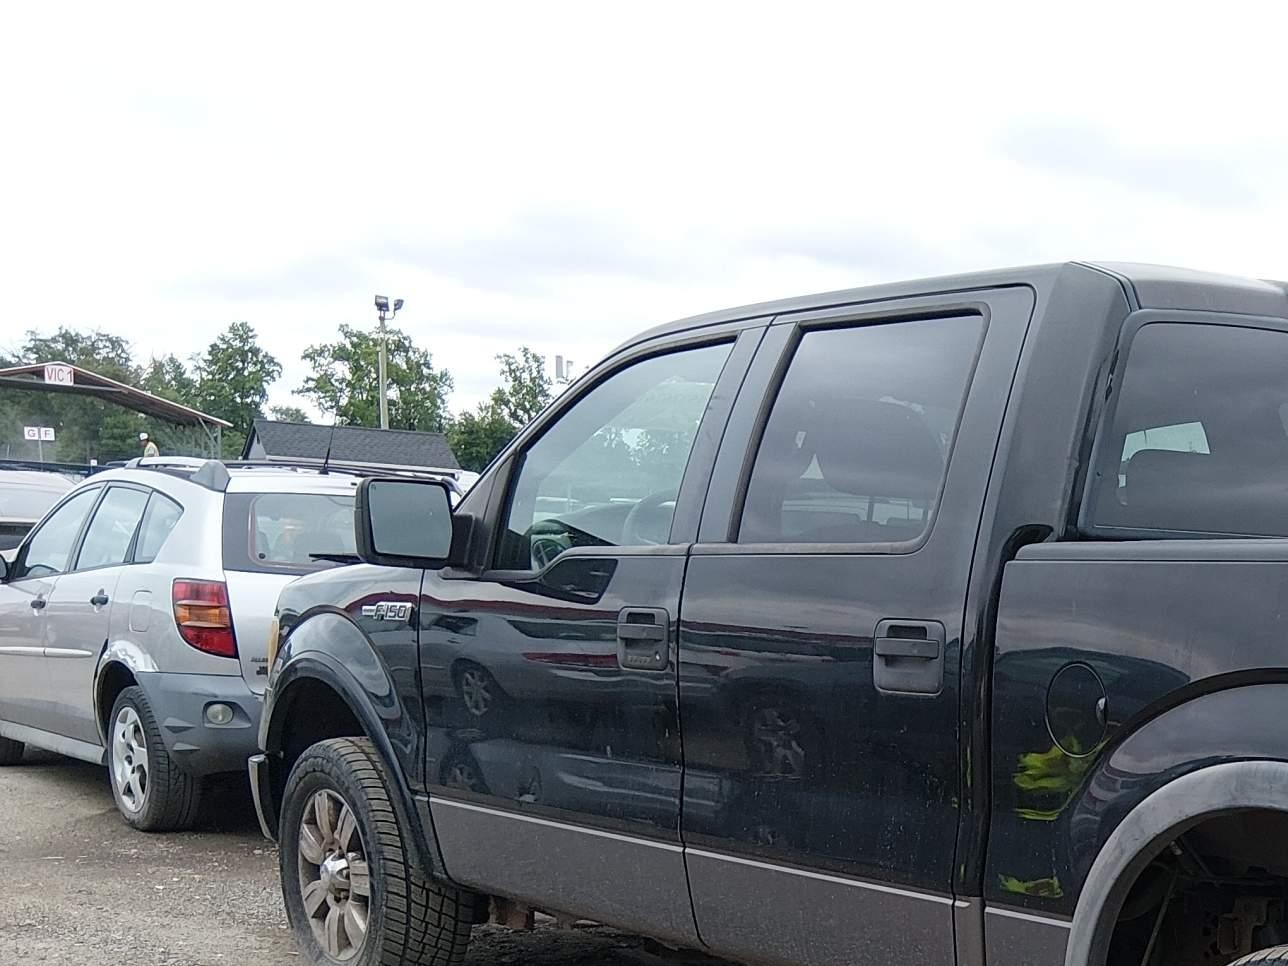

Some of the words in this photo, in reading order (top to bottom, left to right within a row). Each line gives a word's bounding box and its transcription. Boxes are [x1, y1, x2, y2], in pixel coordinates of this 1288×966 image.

[46, 367, 64, 382] VIC
[67, 370, 73, 383] 1
[28, 429, 36, 438] G
[44, 429, 51, 438] F
